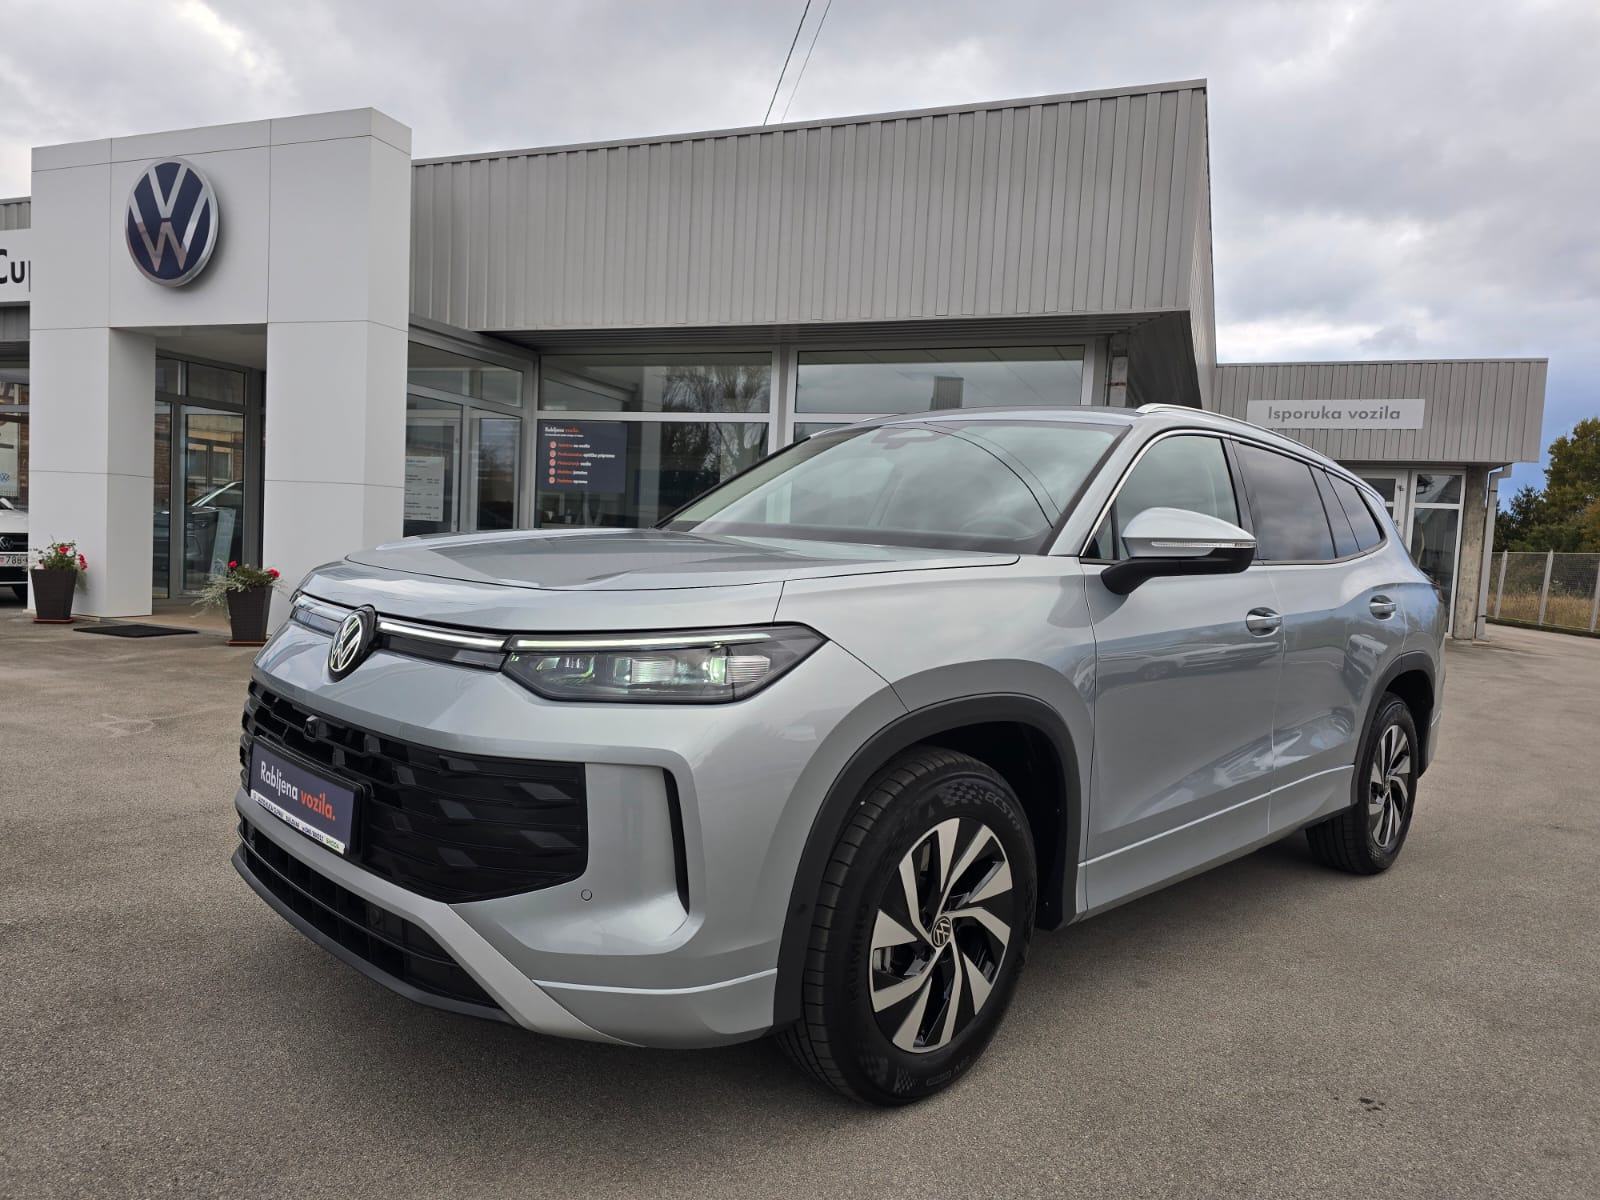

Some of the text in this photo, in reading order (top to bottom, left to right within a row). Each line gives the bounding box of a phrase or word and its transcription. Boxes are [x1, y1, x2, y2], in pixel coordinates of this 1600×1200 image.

[1267, 405, 1401, 423] Isporuka vozila
[260, 760, 299, 801] Rabljena
[301, 790, 336, 821] vozila.
